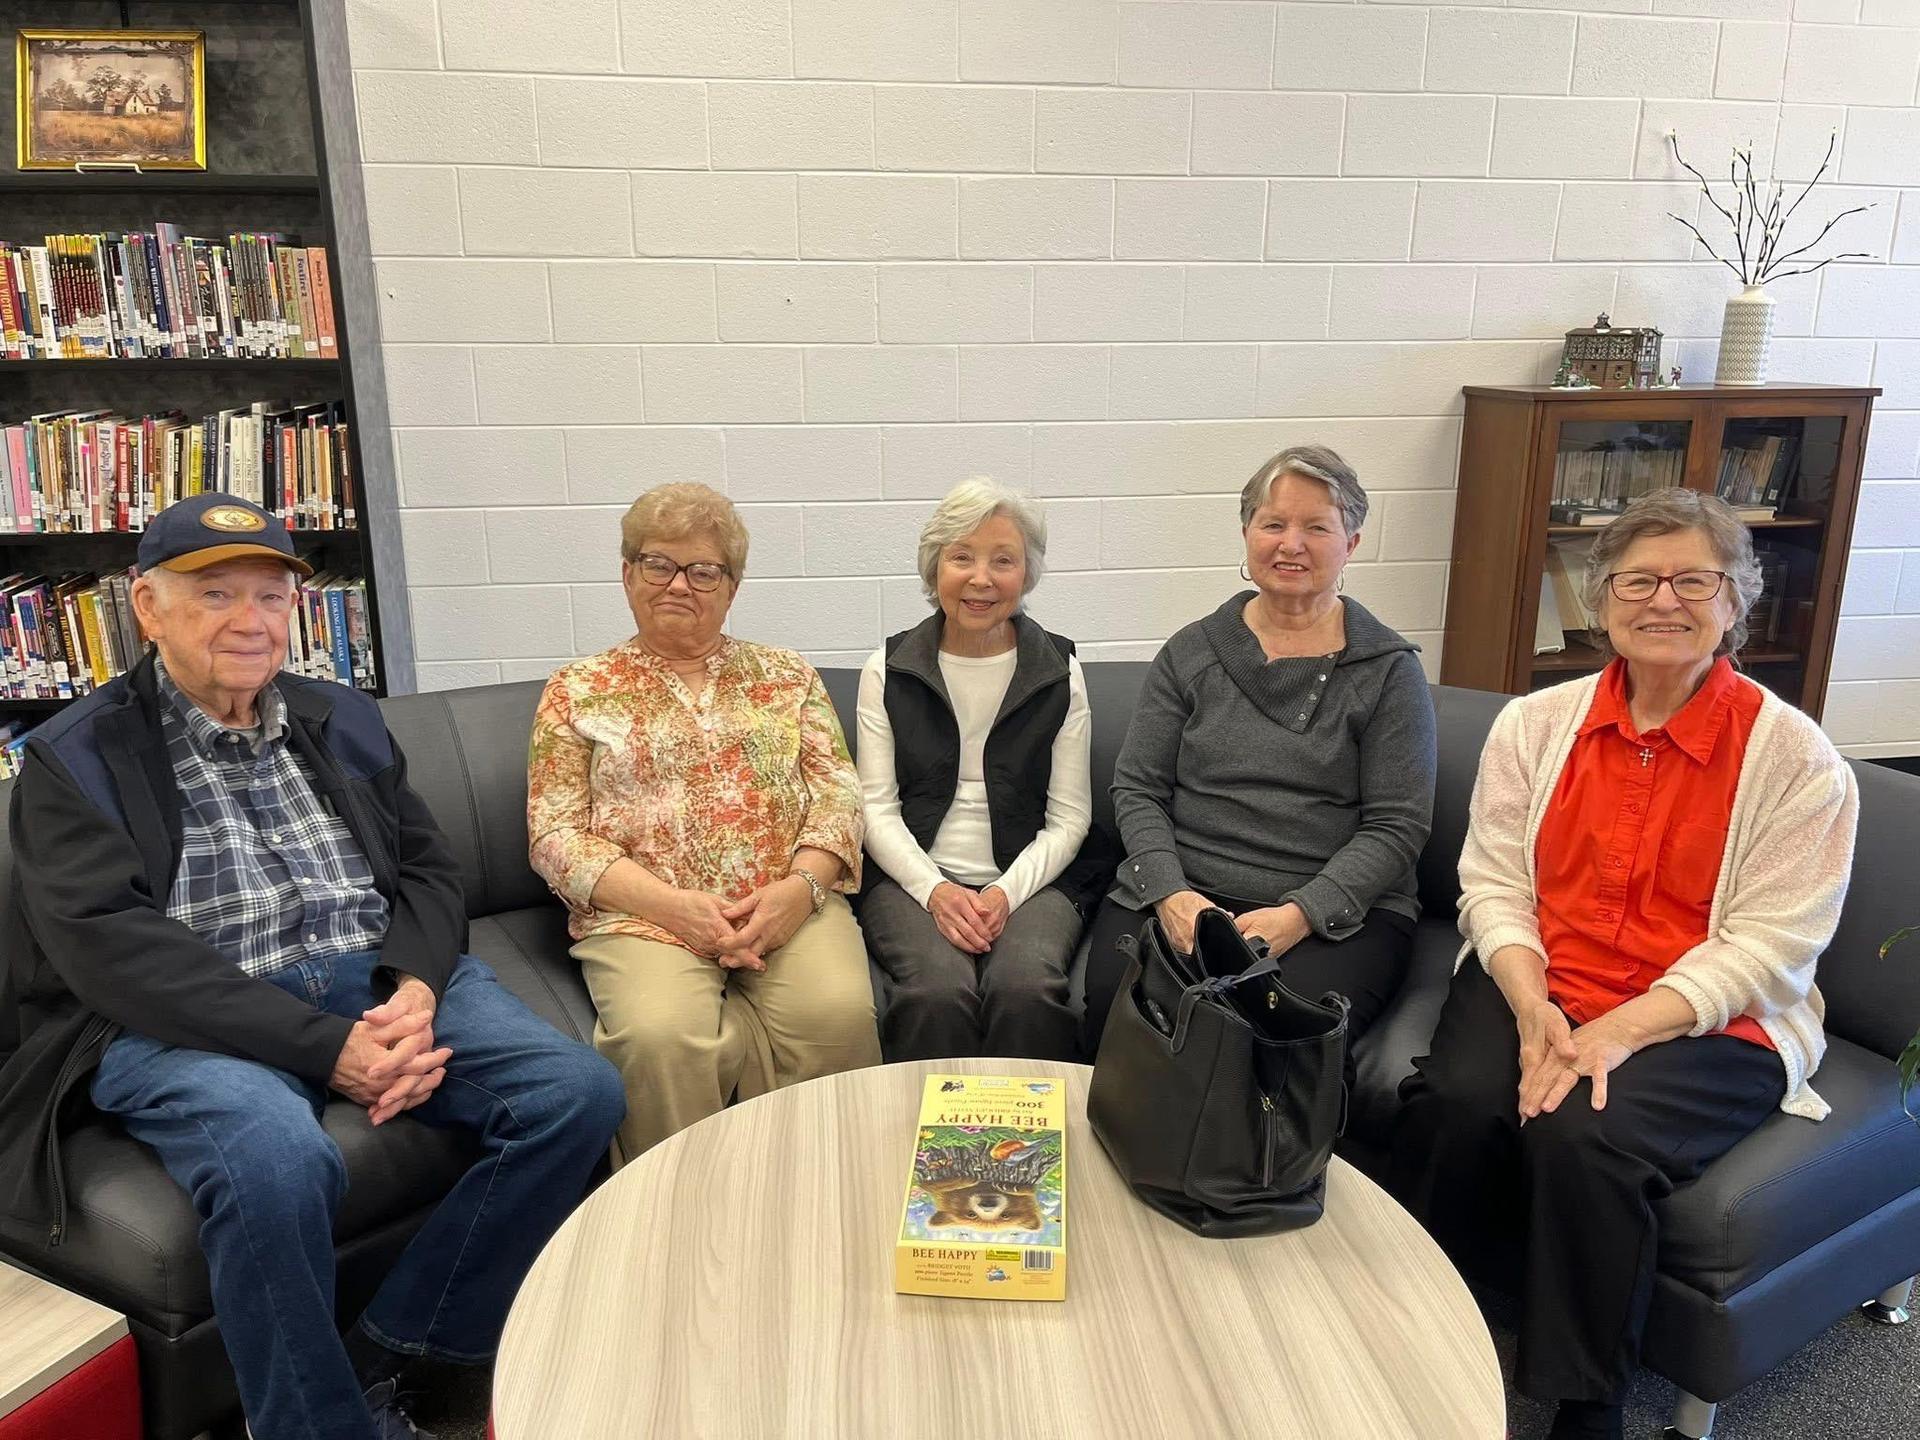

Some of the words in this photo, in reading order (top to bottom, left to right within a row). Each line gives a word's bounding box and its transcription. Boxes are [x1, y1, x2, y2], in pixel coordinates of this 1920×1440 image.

[150, 267, 158, 285] WHITE
[154, 286, 162, 305] HOUSE
[297, 258, 307, 291] Foxfire
[0, 288, 15, 326] VICTORY
[60, 616, 68, 630] THE
[331, 597, 340, 625] LOOKING
[336, 638, 345, 663] ALASKA
[63, 631, 76, 666] COWBOYS
[1015, 1101, 1046, 1109] 300
[935, 1113, 1003, 1124] HAPPY
[1010, 1115, 1048, 1127] BEE
[912, 1248, 935, 1259] BEE
[938, 1249, 978, 1260] HAPPY
